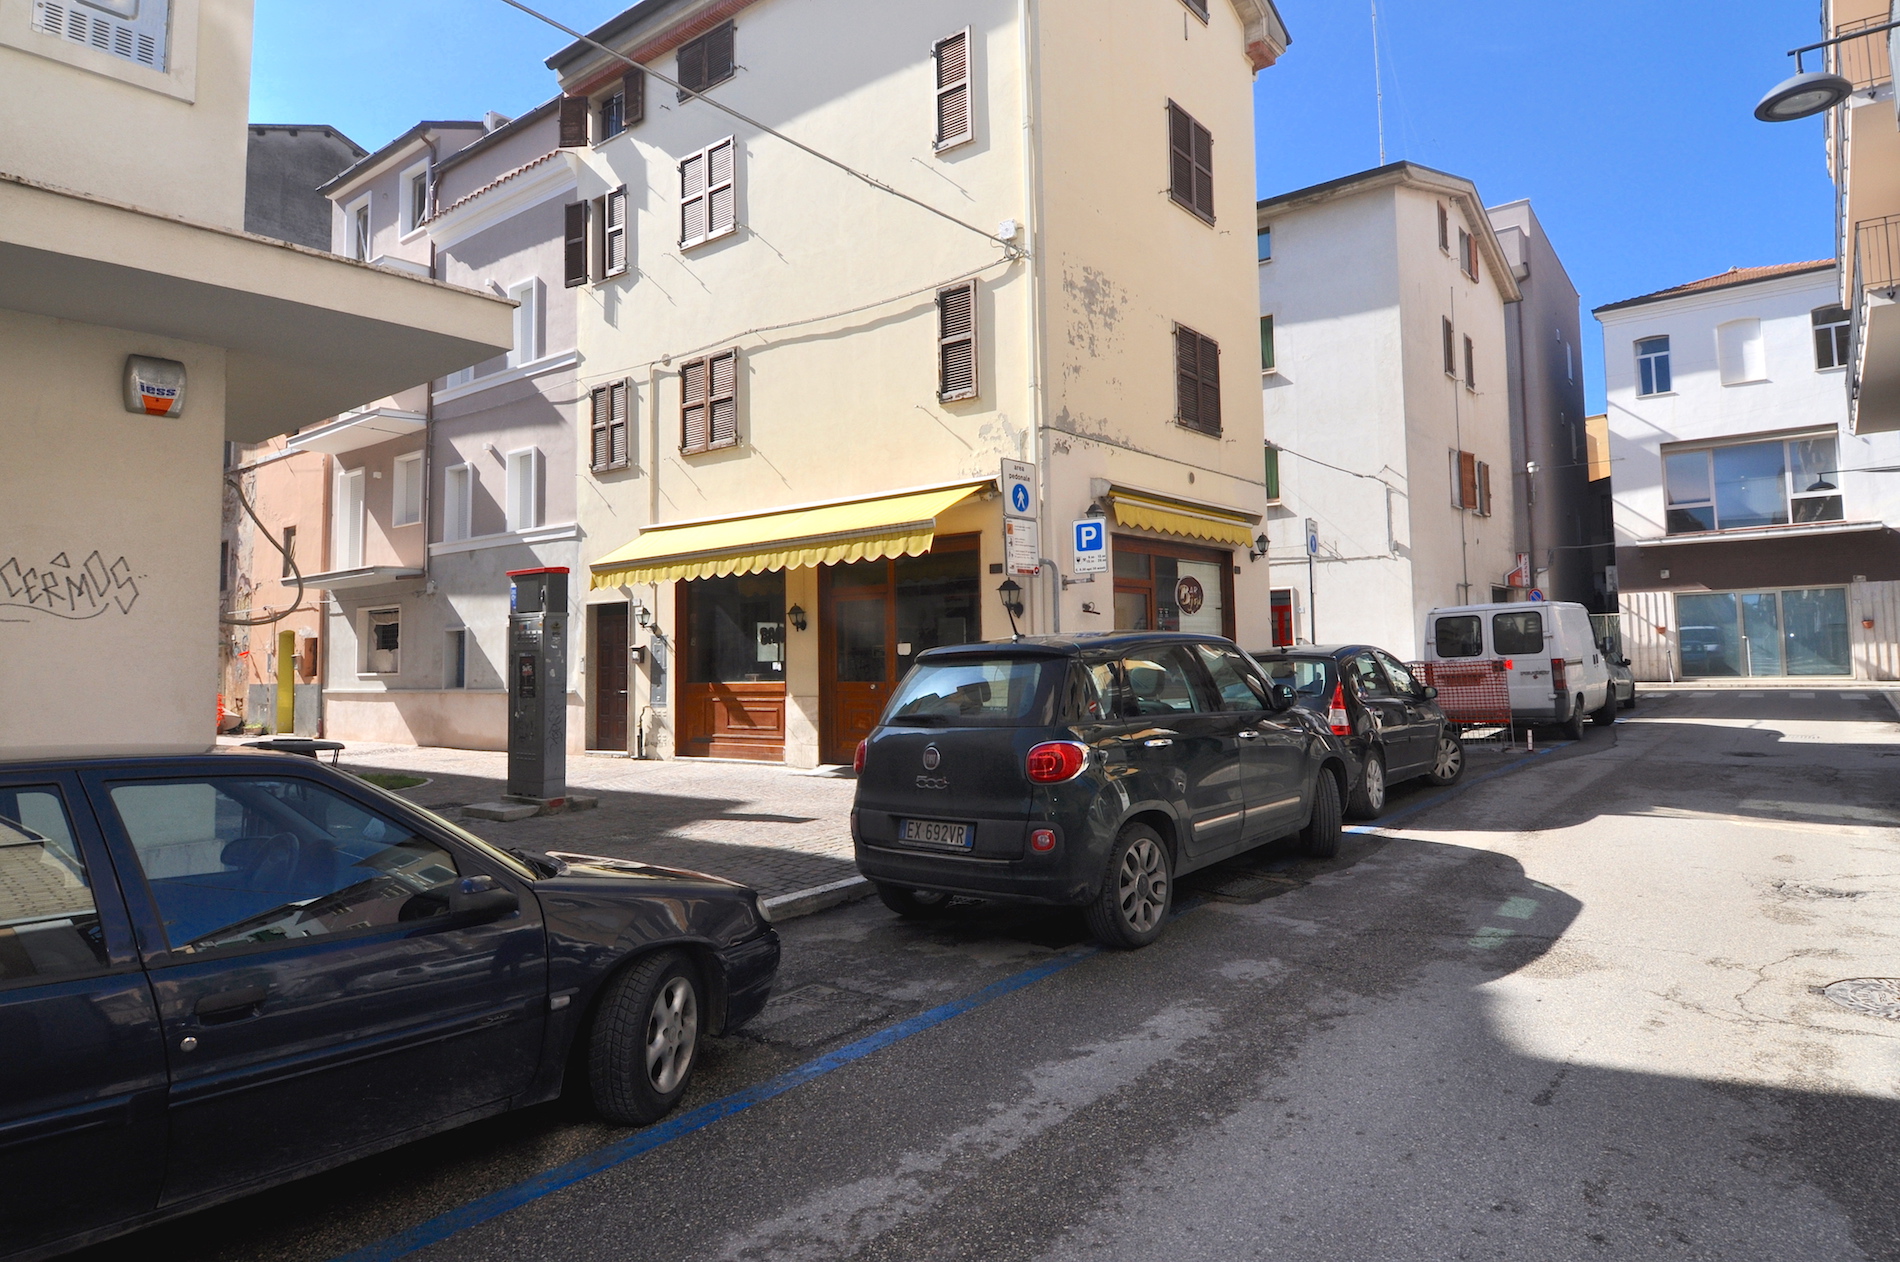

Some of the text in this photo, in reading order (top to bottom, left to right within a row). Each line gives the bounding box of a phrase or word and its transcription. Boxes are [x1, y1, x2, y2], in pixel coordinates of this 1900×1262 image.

[1008, 473, 1031, 482] pedonale
[1081, 526, 1097, 548] P
[907, 822, 965, 844] EX 692VR
